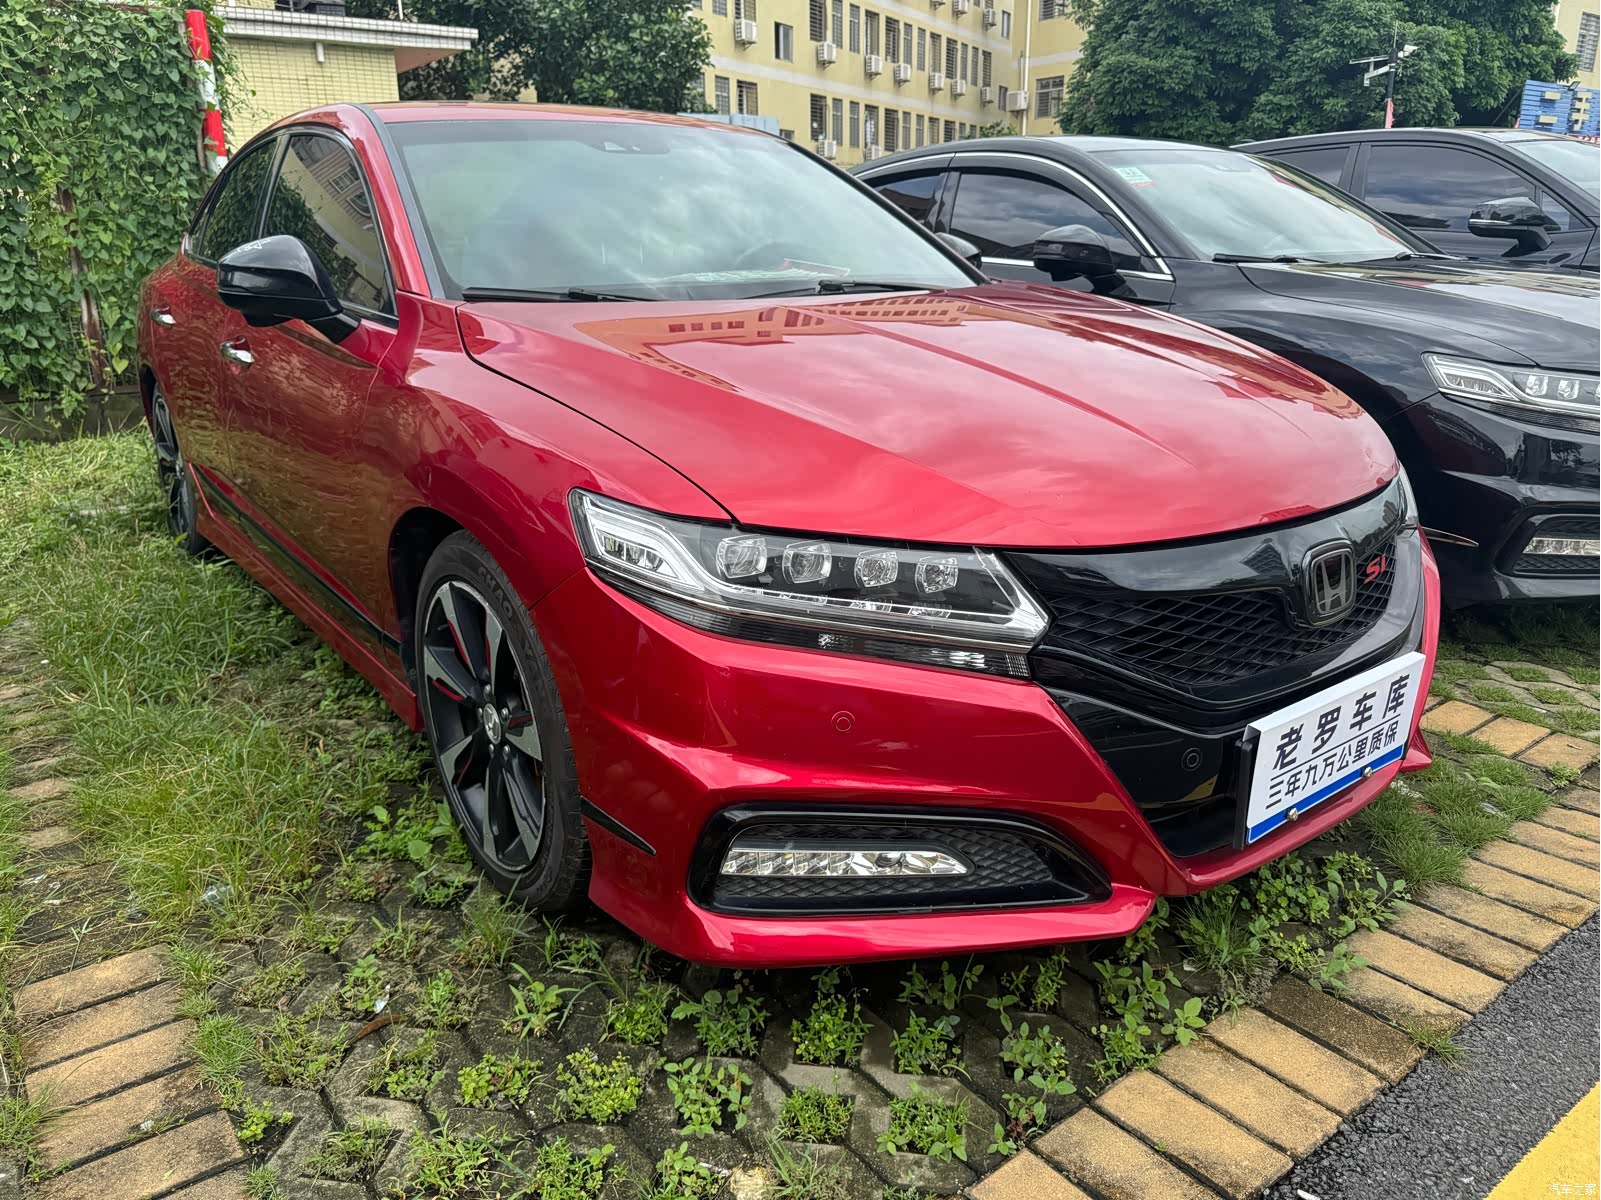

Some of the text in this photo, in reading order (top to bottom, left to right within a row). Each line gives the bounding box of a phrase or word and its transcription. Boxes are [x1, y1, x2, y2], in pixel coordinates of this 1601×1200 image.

[1265, 719, 1399, 810] 三年九万公里质保
[1272, 673, 1410, 771] 老罗车库
